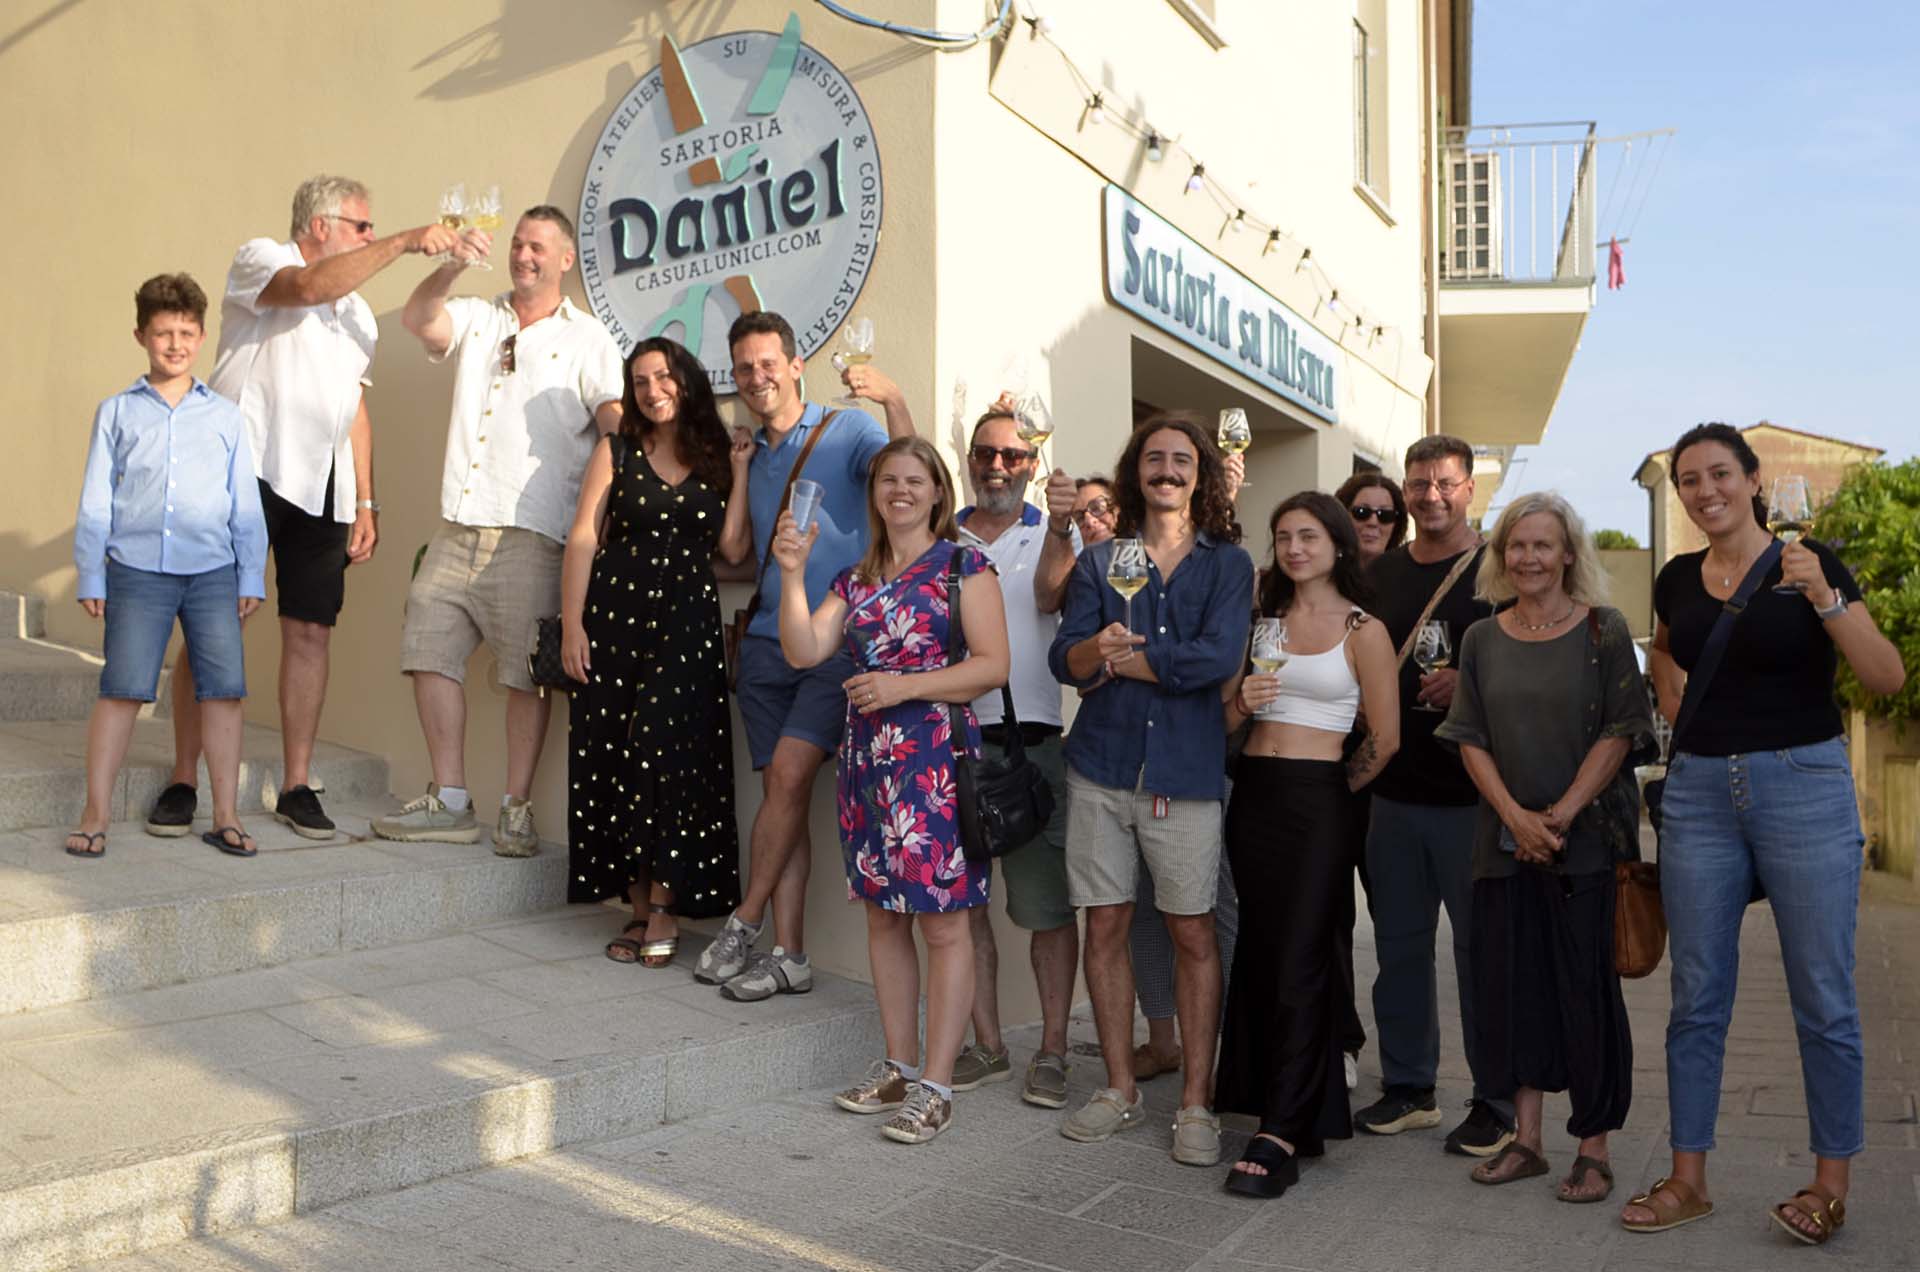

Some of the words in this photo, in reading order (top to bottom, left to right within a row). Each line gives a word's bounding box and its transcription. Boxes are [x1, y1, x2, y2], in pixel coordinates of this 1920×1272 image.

[722, 39, 748, 59] SU
[602, 75, 665, 159] ATELIER
[798, 55, 858, 127] MISURA
[660, 117, 783, 167] SARTORIA
[852, 134, 868, 152] &
[581, 180, 602, 238] LOOK
[608, 137, 848, 276] Daniel
[858, 161, 876, 231] CORSI
[634, 228, 823, 292] CASUALUNICI.COM
[1121, 208, 1231, 350] Sartoria
[582, 249, 634, 353] MARITTIMI
[796, 241, 871, 354] RILASSATI
